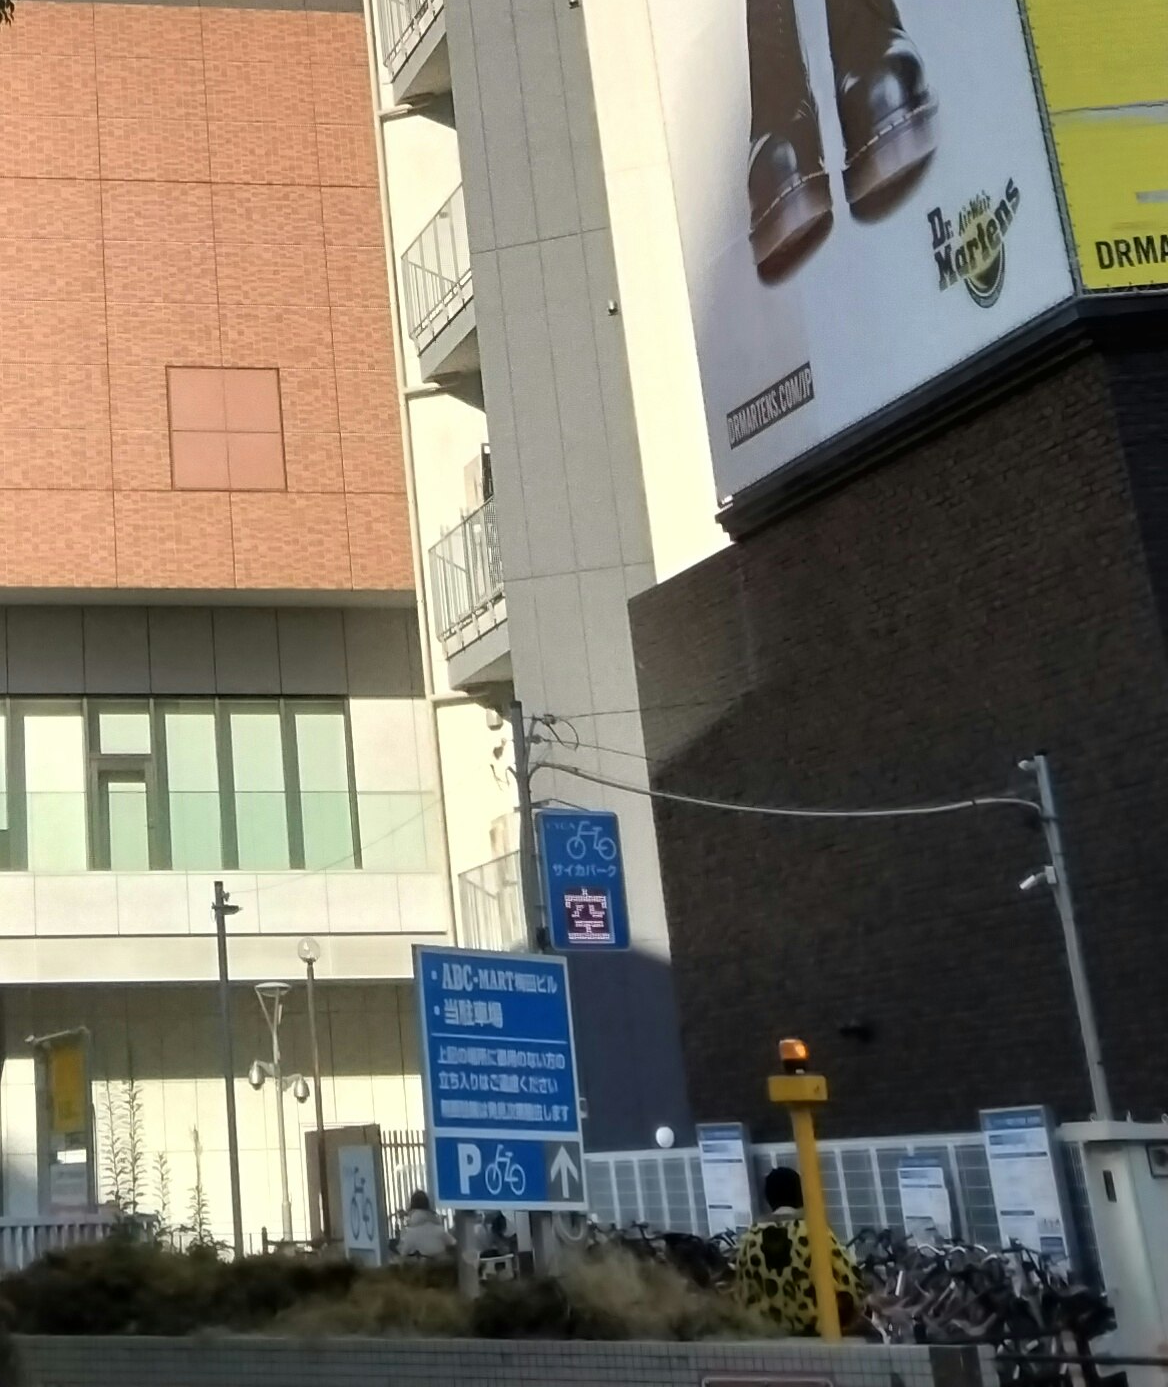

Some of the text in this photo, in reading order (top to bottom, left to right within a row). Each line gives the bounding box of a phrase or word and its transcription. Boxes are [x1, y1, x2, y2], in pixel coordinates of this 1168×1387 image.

[934, 177, 1020, 292] Martens
[564, 887, 610, 940] 空
[457, 1143, 482, 1195] P
